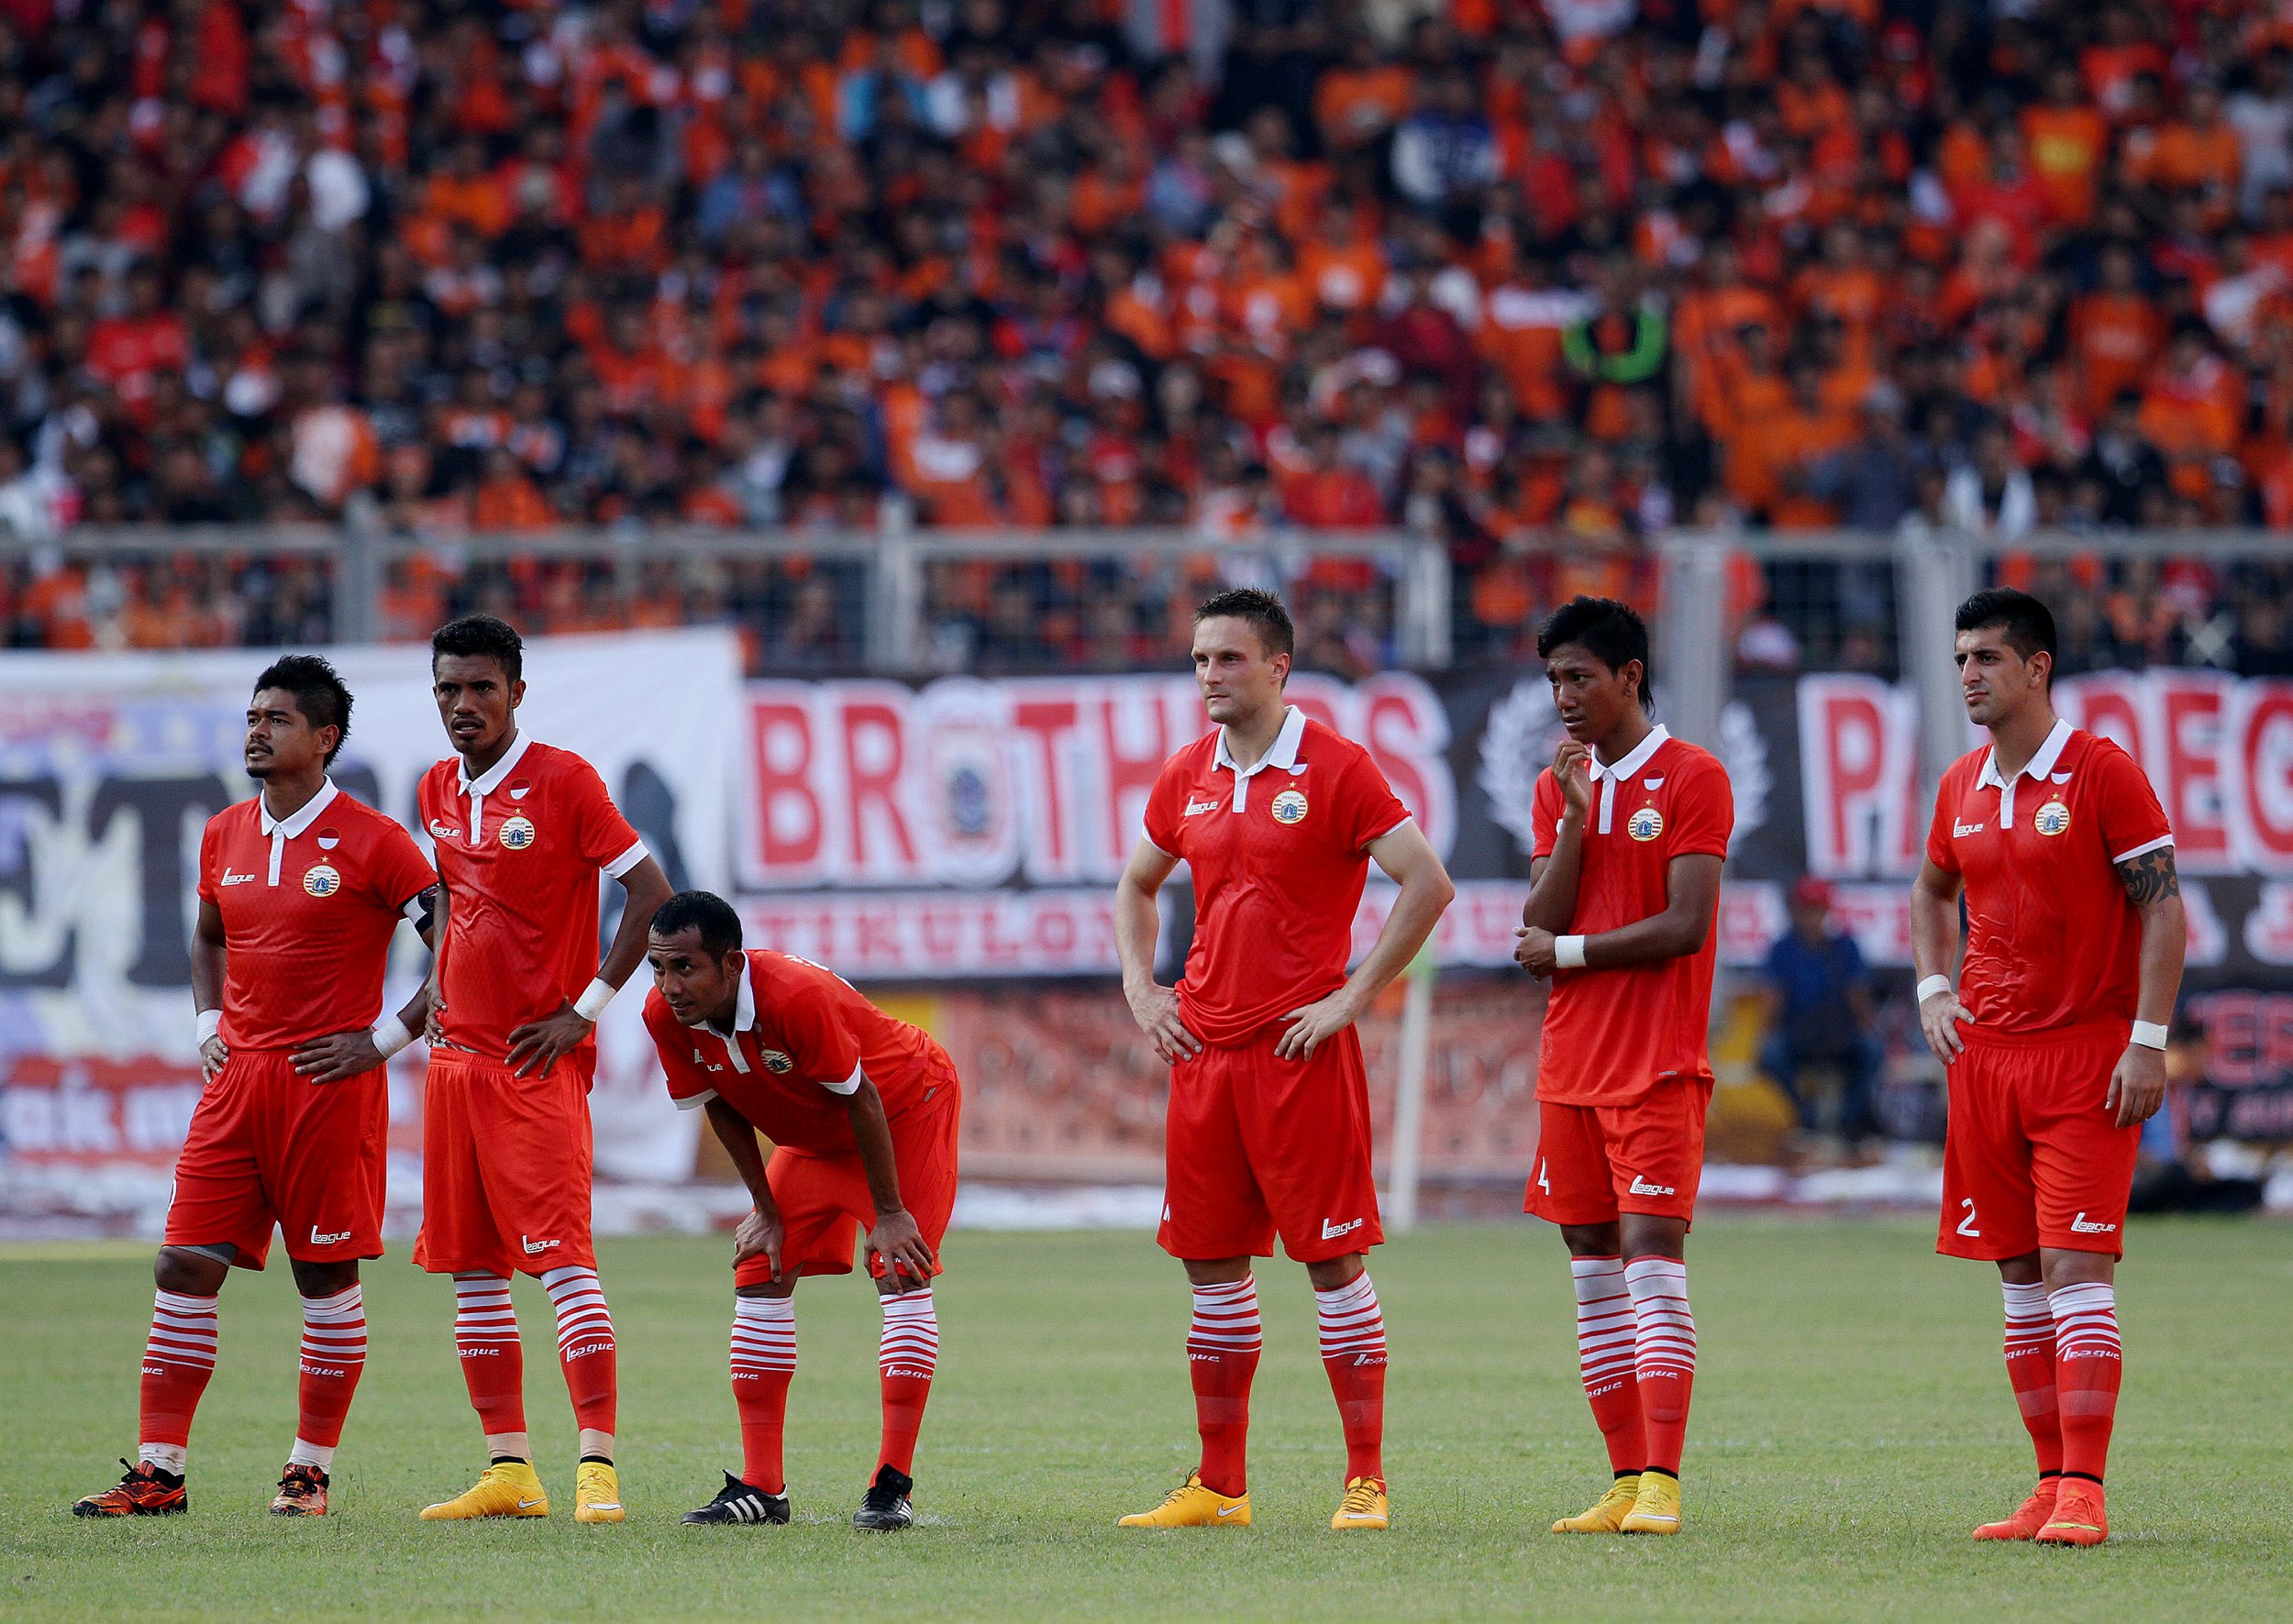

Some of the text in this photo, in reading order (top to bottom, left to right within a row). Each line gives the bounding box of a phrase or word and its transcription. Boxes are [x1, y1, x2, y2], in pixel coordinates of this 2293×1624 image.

[745, 686, 1451, 878] BROTHS
[1184, 795, 1218, 817] League
[429, 818, 460, 838] League
[1953, 816, 1984, 838] League
[220, 867, 255, 887] League
[1629, 1175, 1675, 1196] League
[1955, 1198, 1980, 1238] 2
[2070, 1211, 2116, 1233] League
[311, 1224, 351, 1244] League
[1321, 1217, 1363, 1241] League
[522, 1234, 560, 1254] League
[456, 1344, 500, 1358] ague
[566, 1342, 615, 1363] League
[1190, 1353, 1220, 1363] gue
[1353, 1353, 1388, 1366] Lea
[2003, 1347, 2040, 1361] gue
[2063, 1347, 2121, 1362] League
[731, 1372, 759, 1381] gue
[885, 1365, 933, 1381] League
[1586, 1381, 1623, 1398] ague
